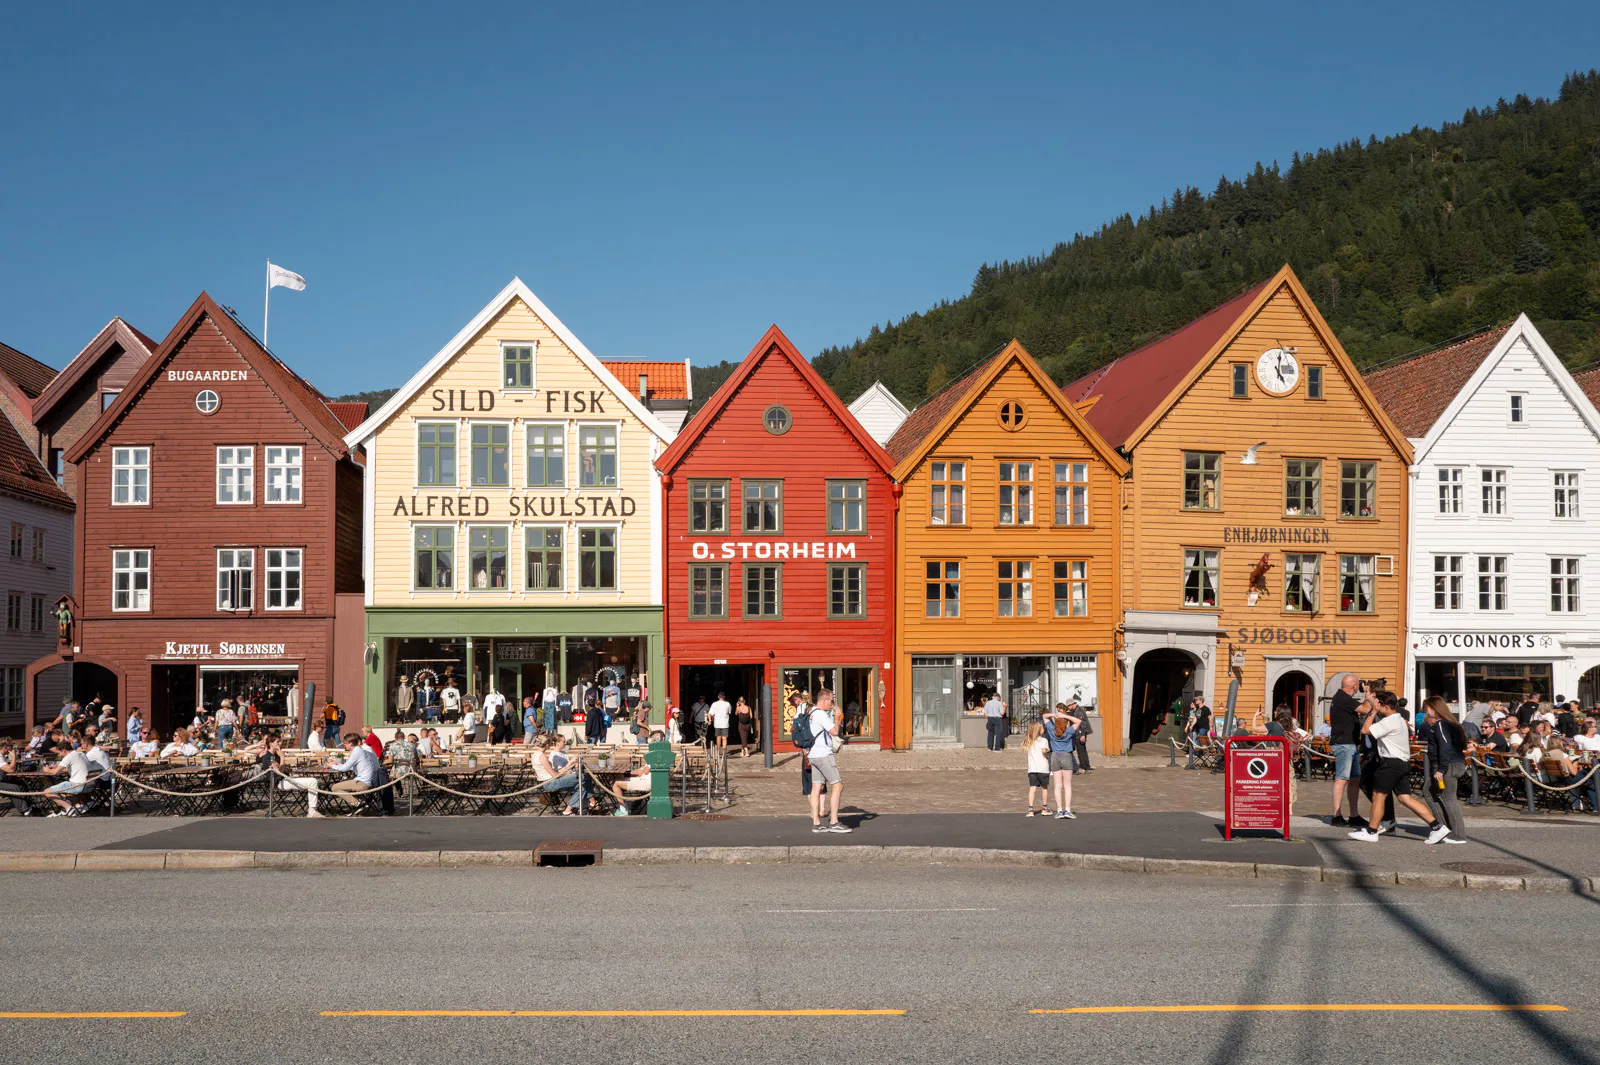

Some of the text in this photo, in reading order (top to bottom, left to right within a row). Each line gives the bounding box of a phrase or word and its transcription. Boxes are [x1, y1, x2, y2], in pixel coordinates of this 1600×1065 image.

[167, 370, 248, 381] BUGAARDEN
[432, 389, 495, 412] SILD
[546, 390, 606, 413] FISK
[393, 495, 636, 517] ALFRED SKULSTAD
[1223, 526, 1330, 544] ENHJØRNINGEN
[692, 542, 856, 559] O. STORHEIM
[1237, 627, 1347, 645] SJØBODEN
[1438, 634, 1535, 648] O'CONNOR'S
